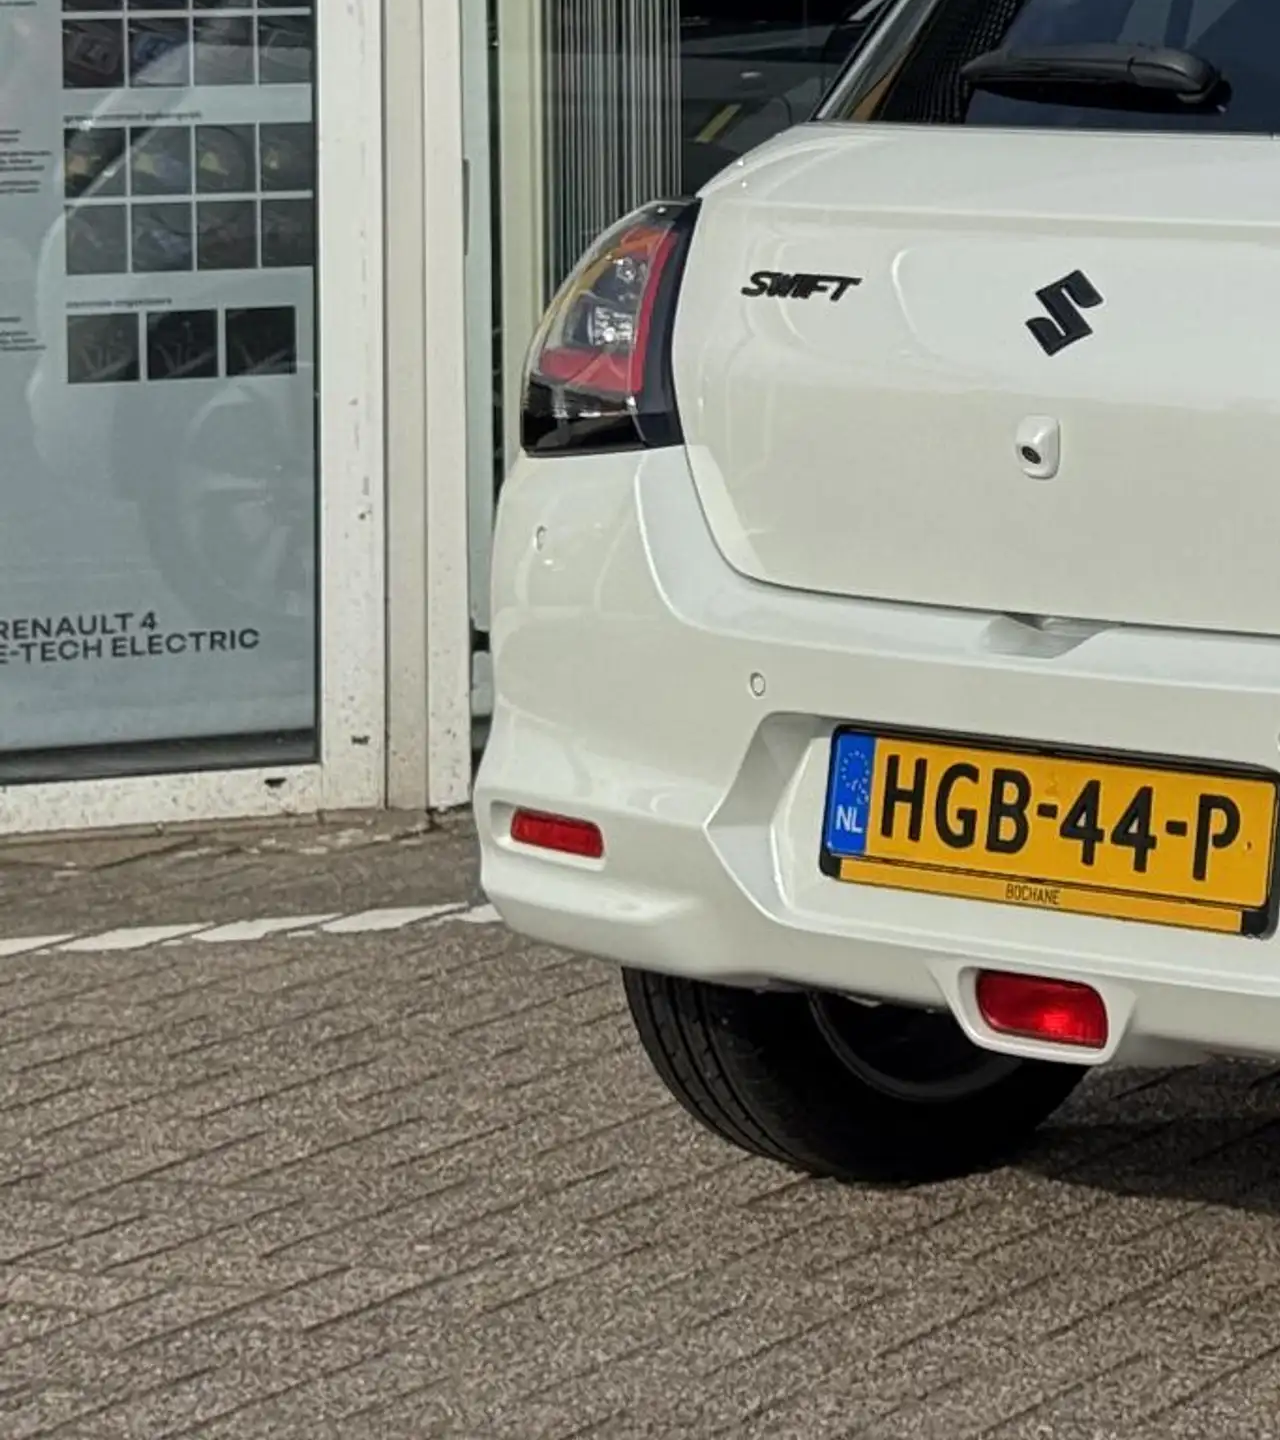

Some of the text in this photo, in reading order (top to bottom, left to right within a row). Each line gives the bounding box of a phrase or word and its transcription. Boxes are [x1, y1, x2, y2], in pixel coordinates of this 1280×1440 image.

[741, 270, 863, 302] SWIFT
[139, 611, 158, 631] 4
[110, 627, 260, 658] ELECTRIC
[835, 804, 863, 834] NL
[880, 753, 1241, 881] HGB-44-P
[1005, 882, 1060, 906] BOCHANE
